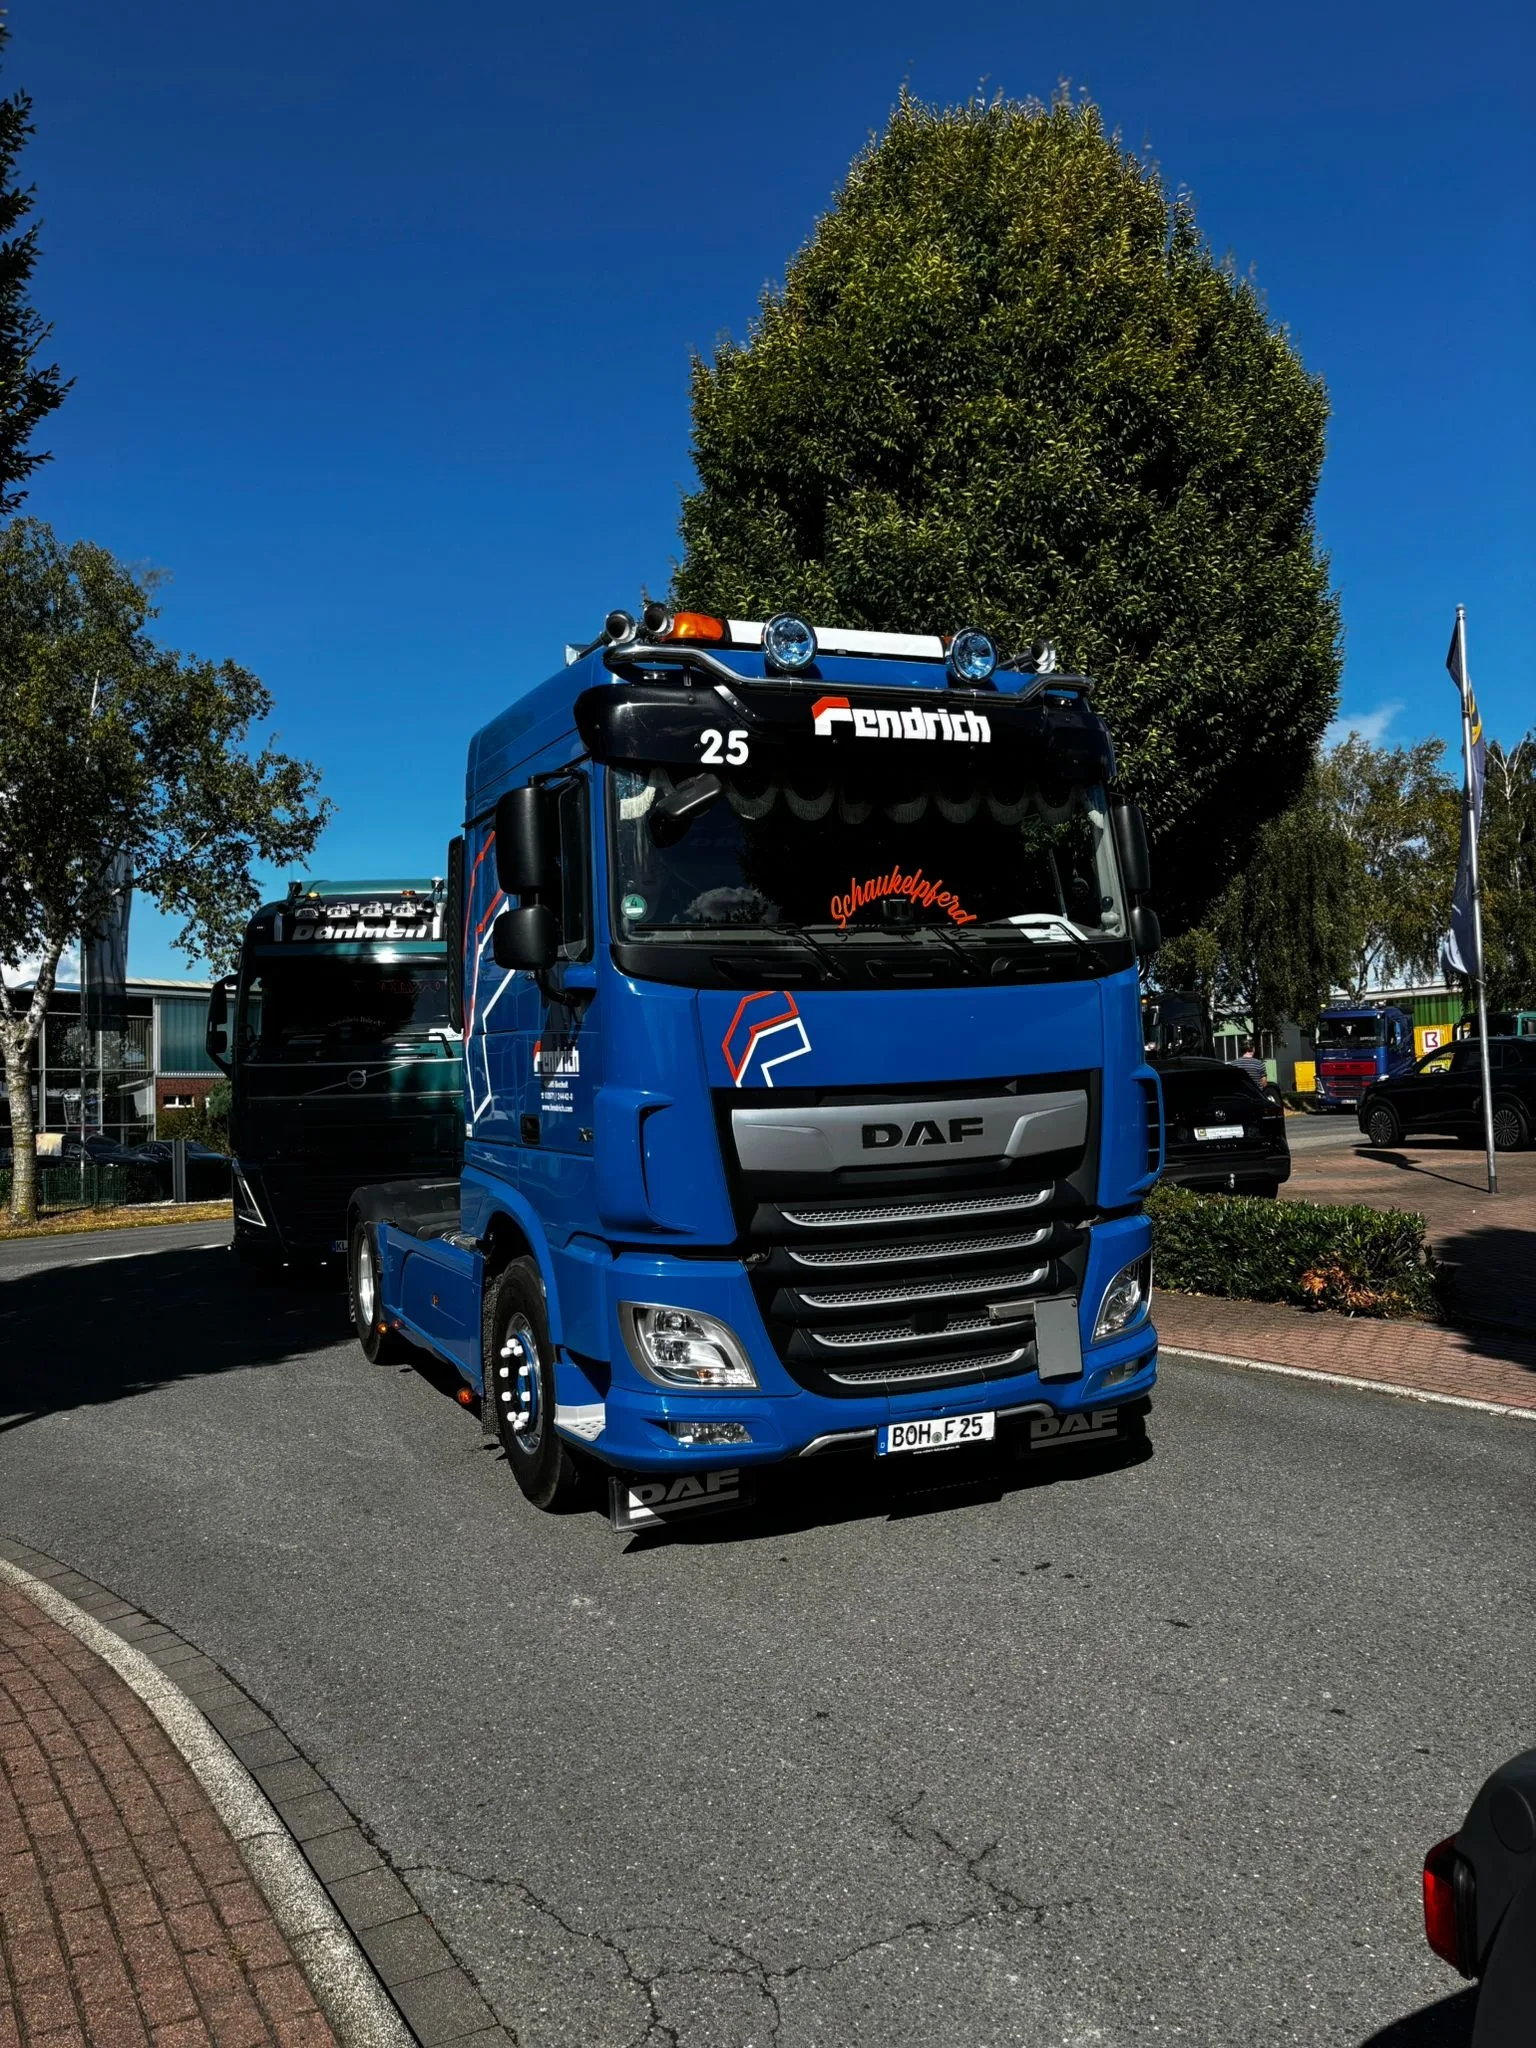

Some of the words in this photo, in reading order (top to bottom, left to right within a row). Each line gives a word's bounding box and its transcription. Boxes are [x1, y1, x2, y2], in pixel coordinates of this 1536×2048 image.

[811, 696, 991, 743] Fendrich
[700, 729, 749, 765] 25
[630, 897, 638, 907] 4
[831, 865, 977, 929] Schaukelpferd
[862, 1117, 983, 1149] DAF
[892, 1422, 932, 1448] BOH
[943, 1419, 957, 1442] F
[959, 1415, 984, 1439] 25
[1029, 1407, 1119, 1440] DAF
[627, 1467, 740, 1509] DAF
